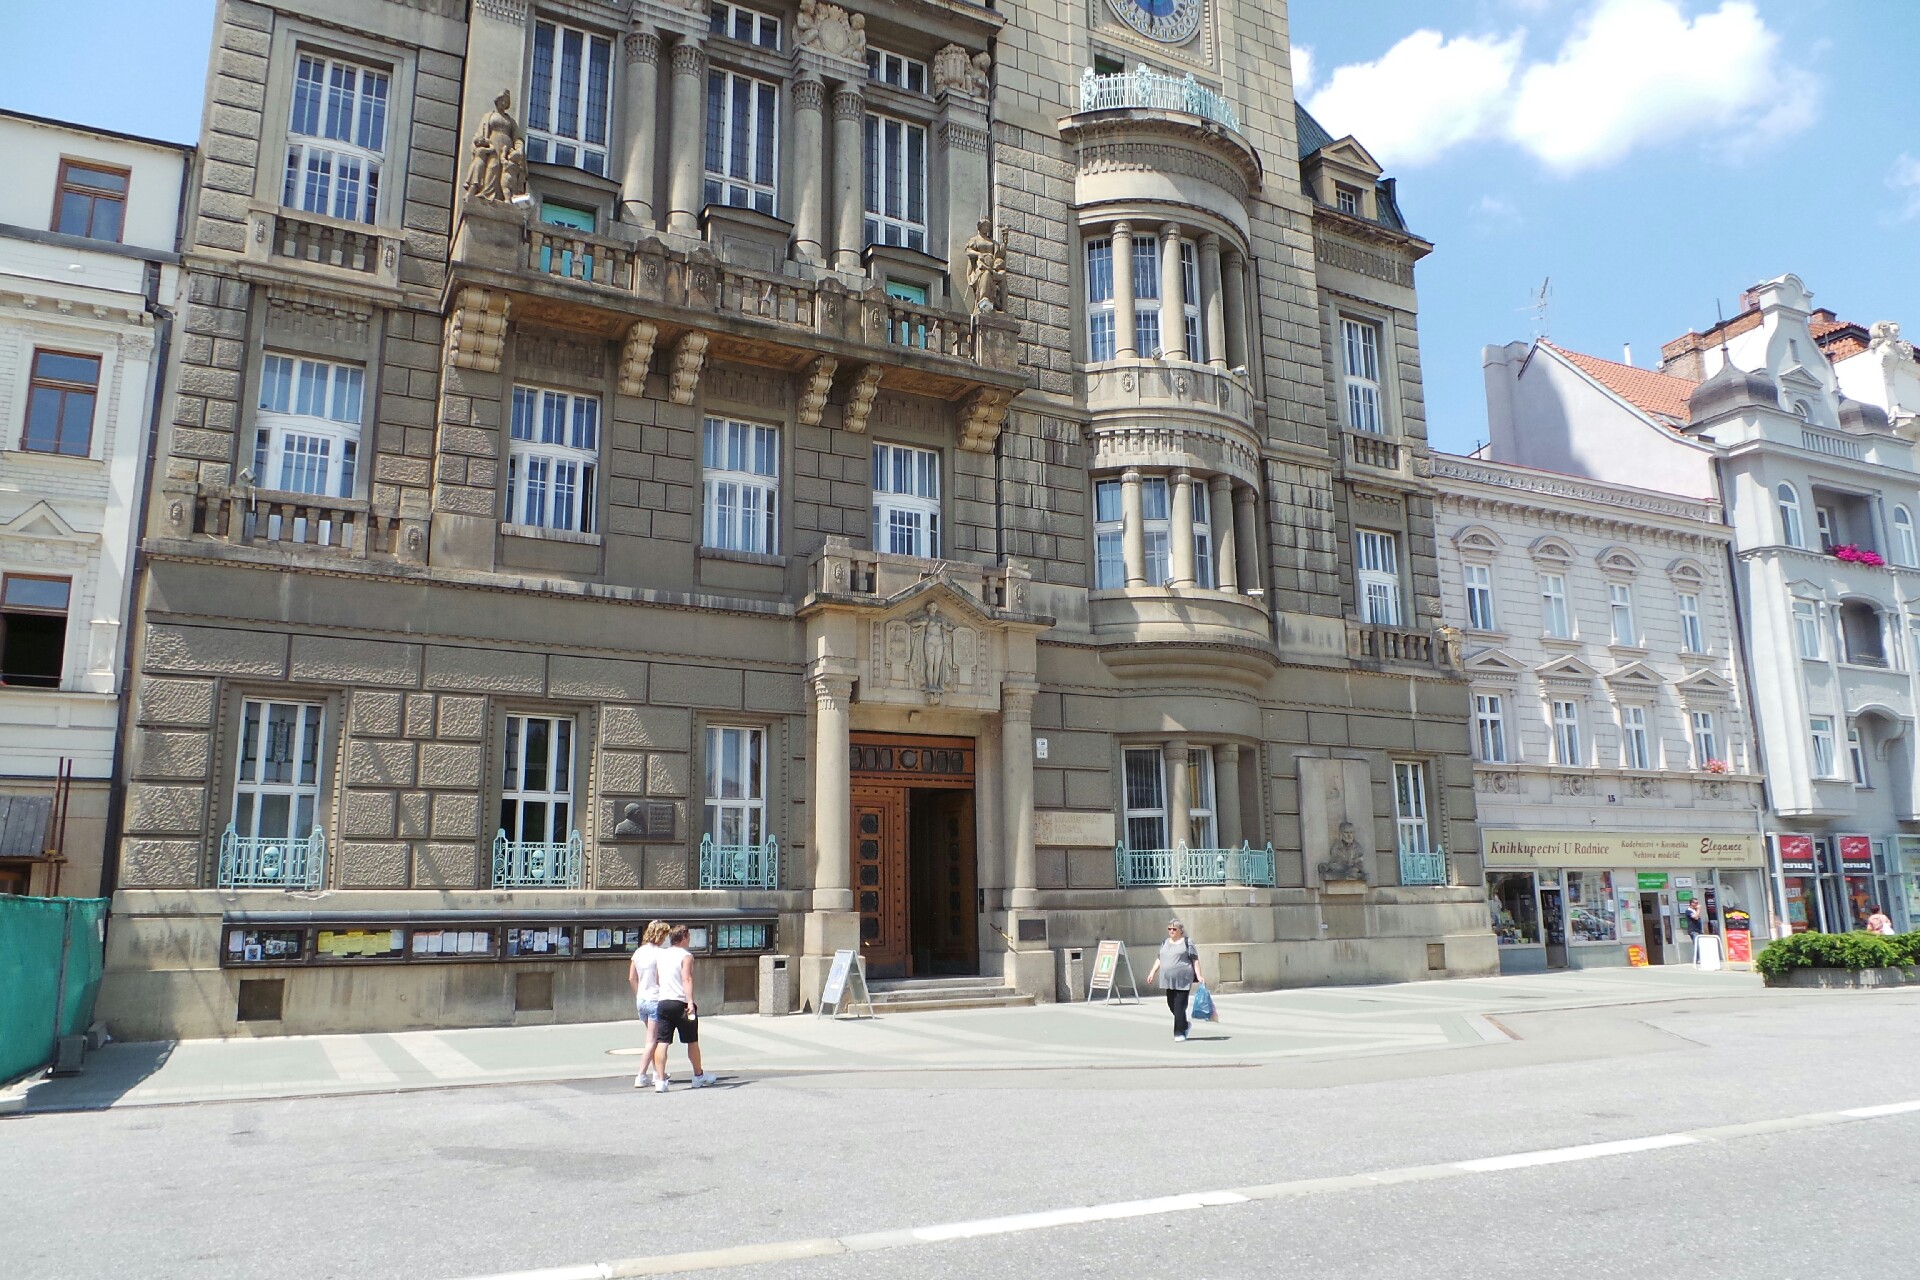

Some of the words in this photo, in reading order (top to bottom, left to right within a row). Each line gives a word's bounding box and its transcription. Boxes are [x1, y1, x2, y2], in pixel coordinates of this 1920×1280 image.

[1607, 794, 1616, 803] 15
[1490, 841, 1560, 857] Knihkupectví
[1564, 842, 1572, 854] U
[1574, 842, 1610, 854] Radnice
[1660, 840, 1689, 848] Kosmetika
[1700, 837, 1743, 855] Elegance
